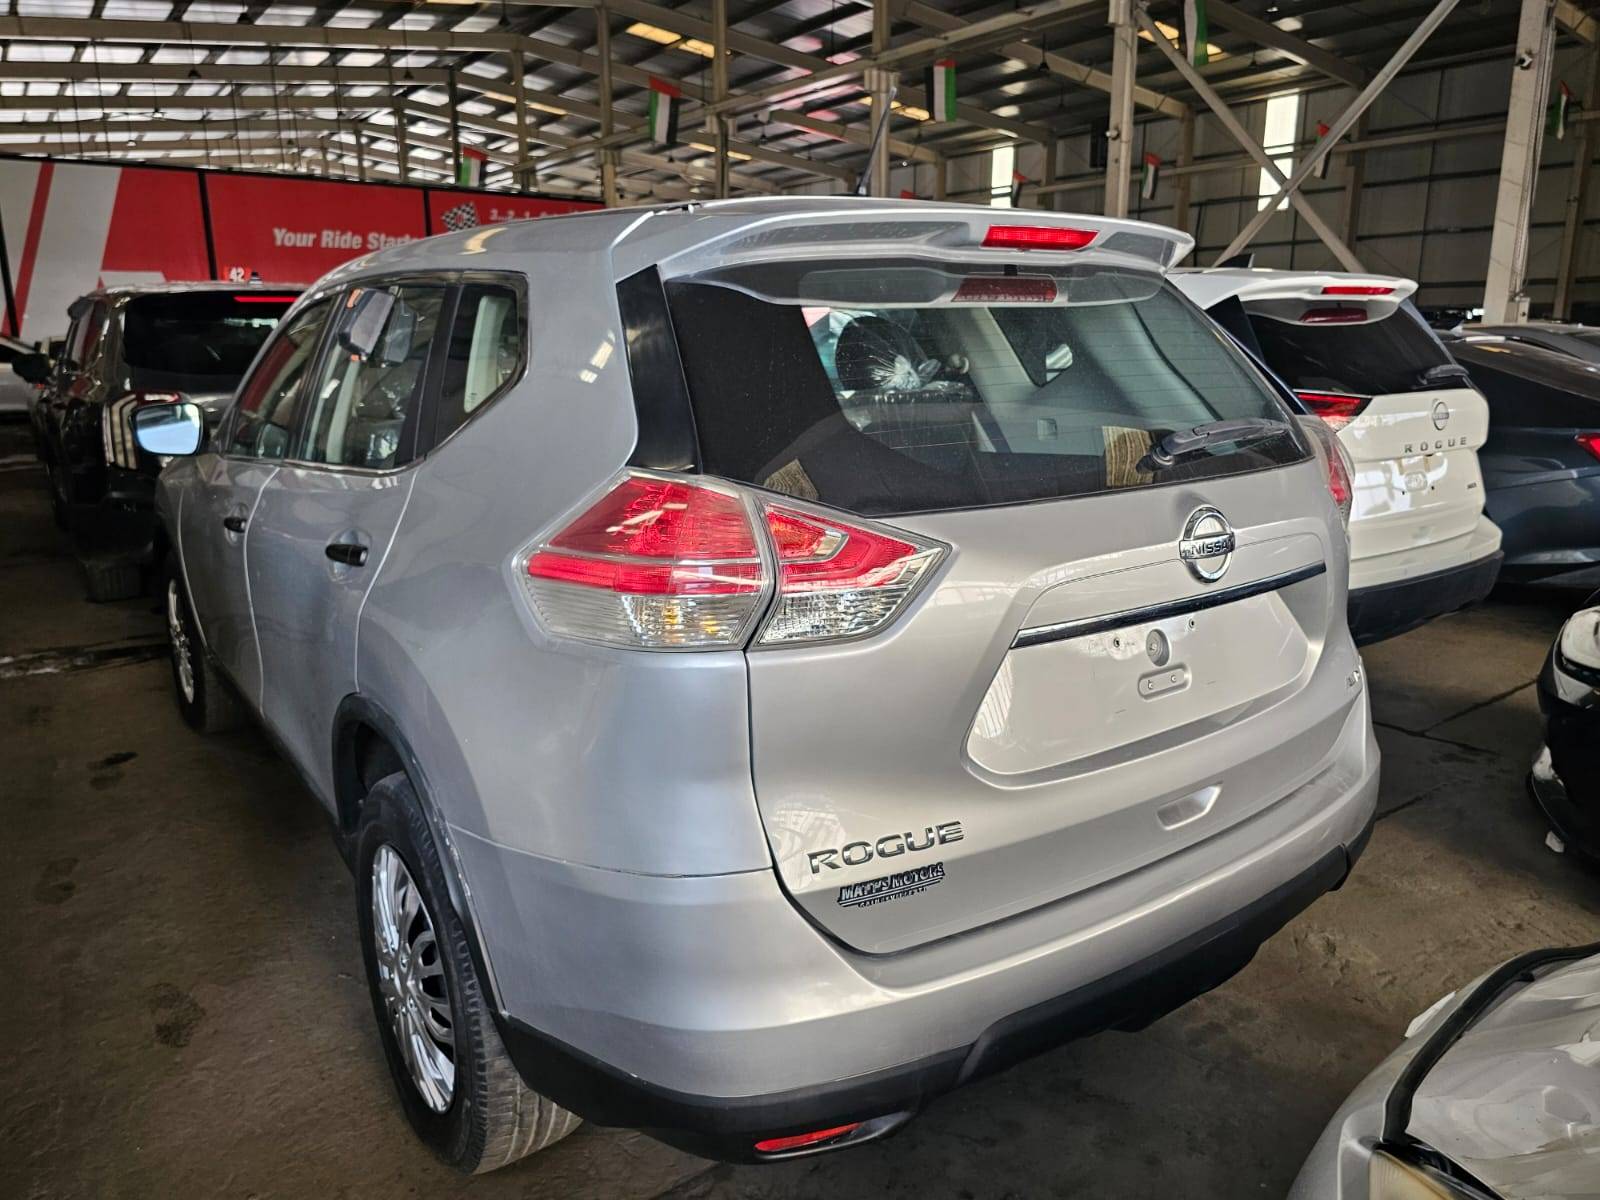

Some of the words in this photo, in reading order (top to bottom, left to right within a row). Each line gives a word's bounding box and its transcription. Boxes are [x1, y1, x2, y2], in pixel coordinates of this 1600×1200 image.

[272, 228, 316, 247] Your
[320, 229, 362, 249] Ride
[367, 231, 418, 250] Start
[1404, 437, 1467, 453] ROGUE
[1191, 537, 1235, 556] NISSAN
[807, 821, 964, 874] ROGUE
[891, 862, 945, 889] MOTORS
